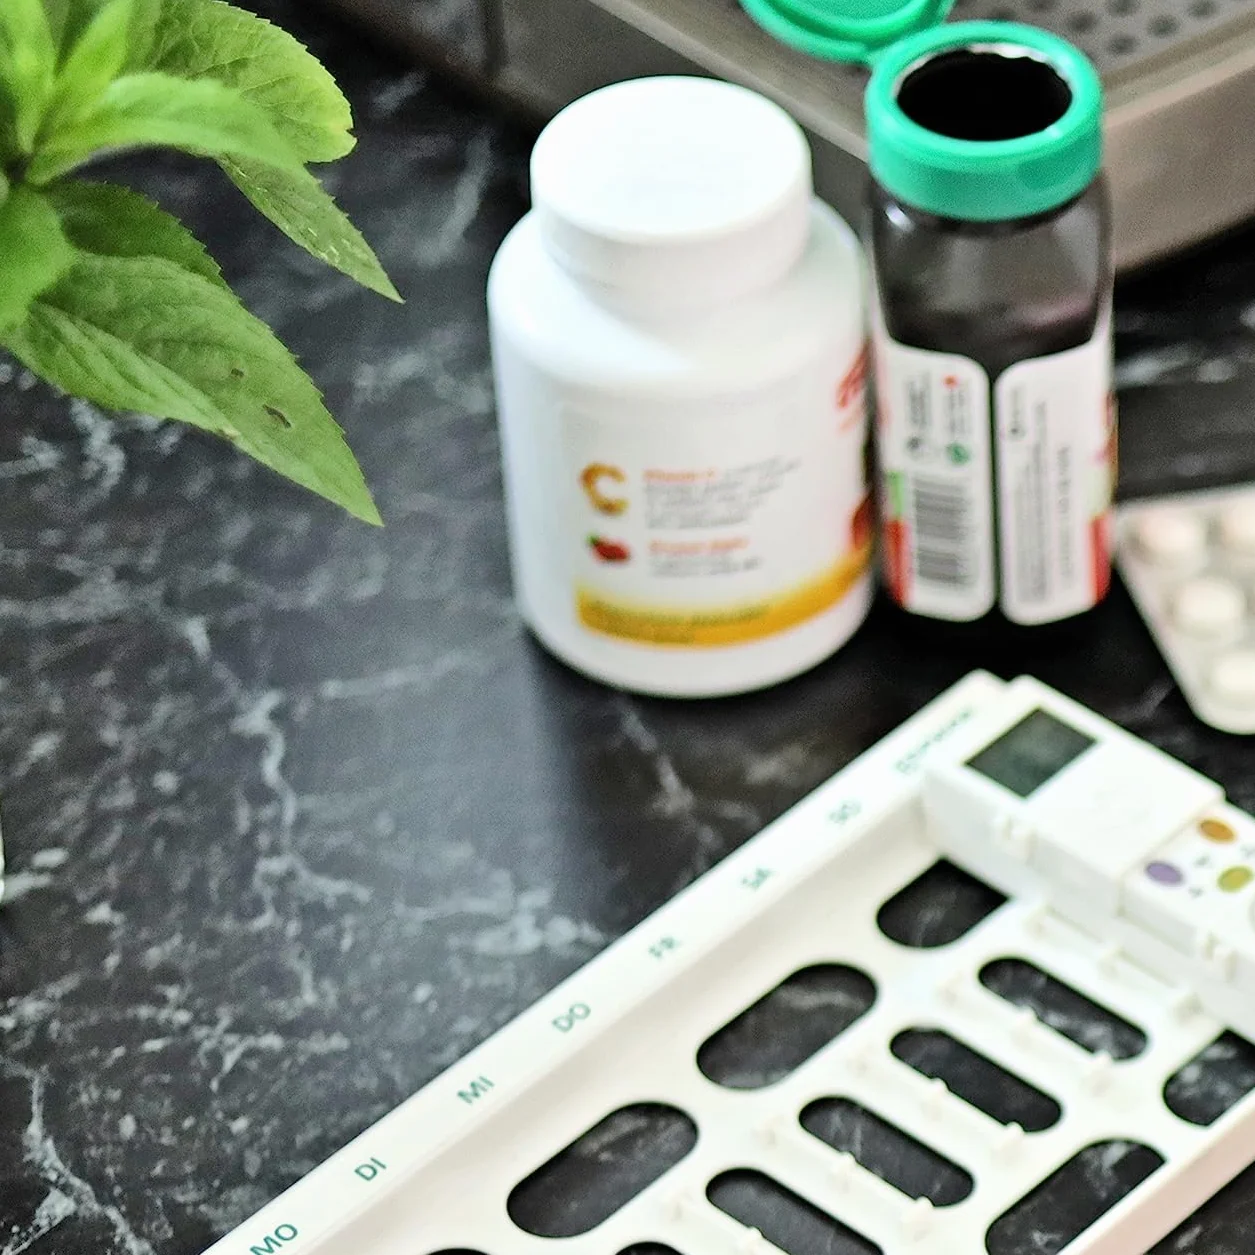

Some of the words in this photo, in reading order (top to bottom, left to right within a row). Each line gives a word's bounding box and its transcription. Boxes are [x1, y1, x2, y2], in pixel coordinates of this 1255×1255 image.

[354, 1157, 387, 1182] DI
[457, 1076, 496, 1104] MI
[552, 1002, 592, 1033] DO
